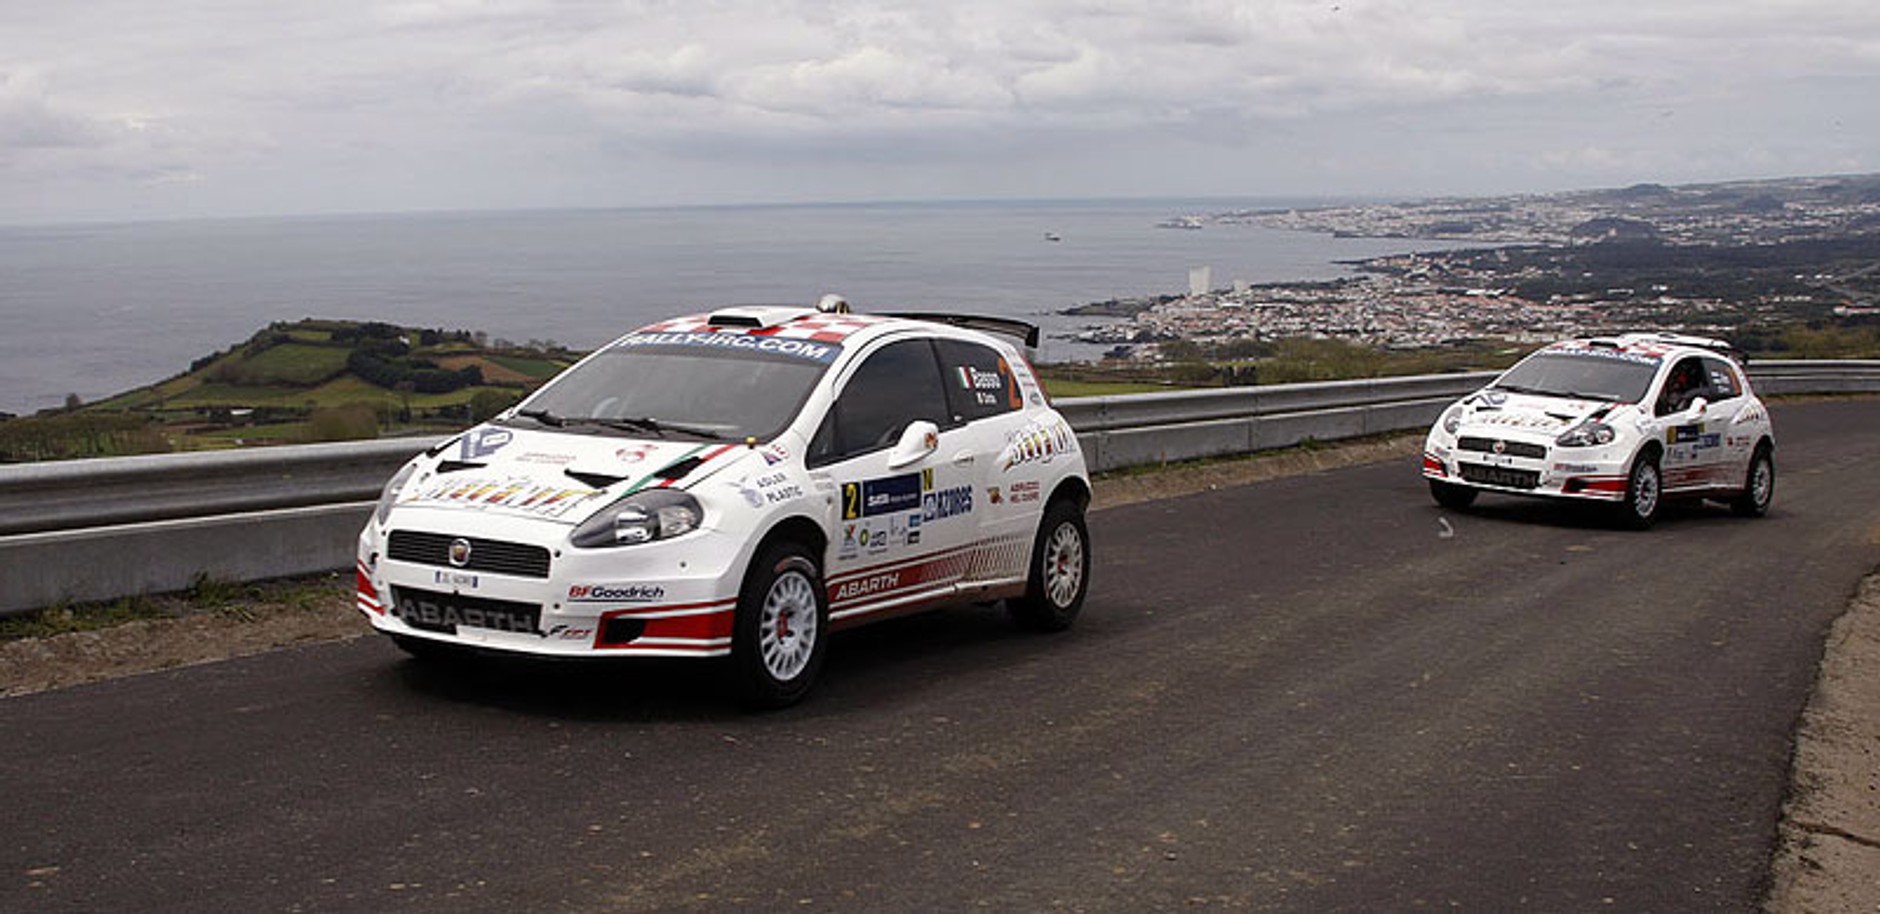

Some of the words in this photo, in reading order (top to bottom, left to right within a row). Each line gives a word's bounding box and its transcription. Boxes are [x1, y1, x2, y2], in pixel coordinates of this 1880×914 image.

[970, 366, 1001, 388] Basso
[766, 486, 803, 503] PLASTIC
[843, 482, 858, 519] 2
[568, 585, 666, 599] BFGoodrich
[836, 573, 899, 600] ABARTH
[400, 599, 534, 634] ABARTH
